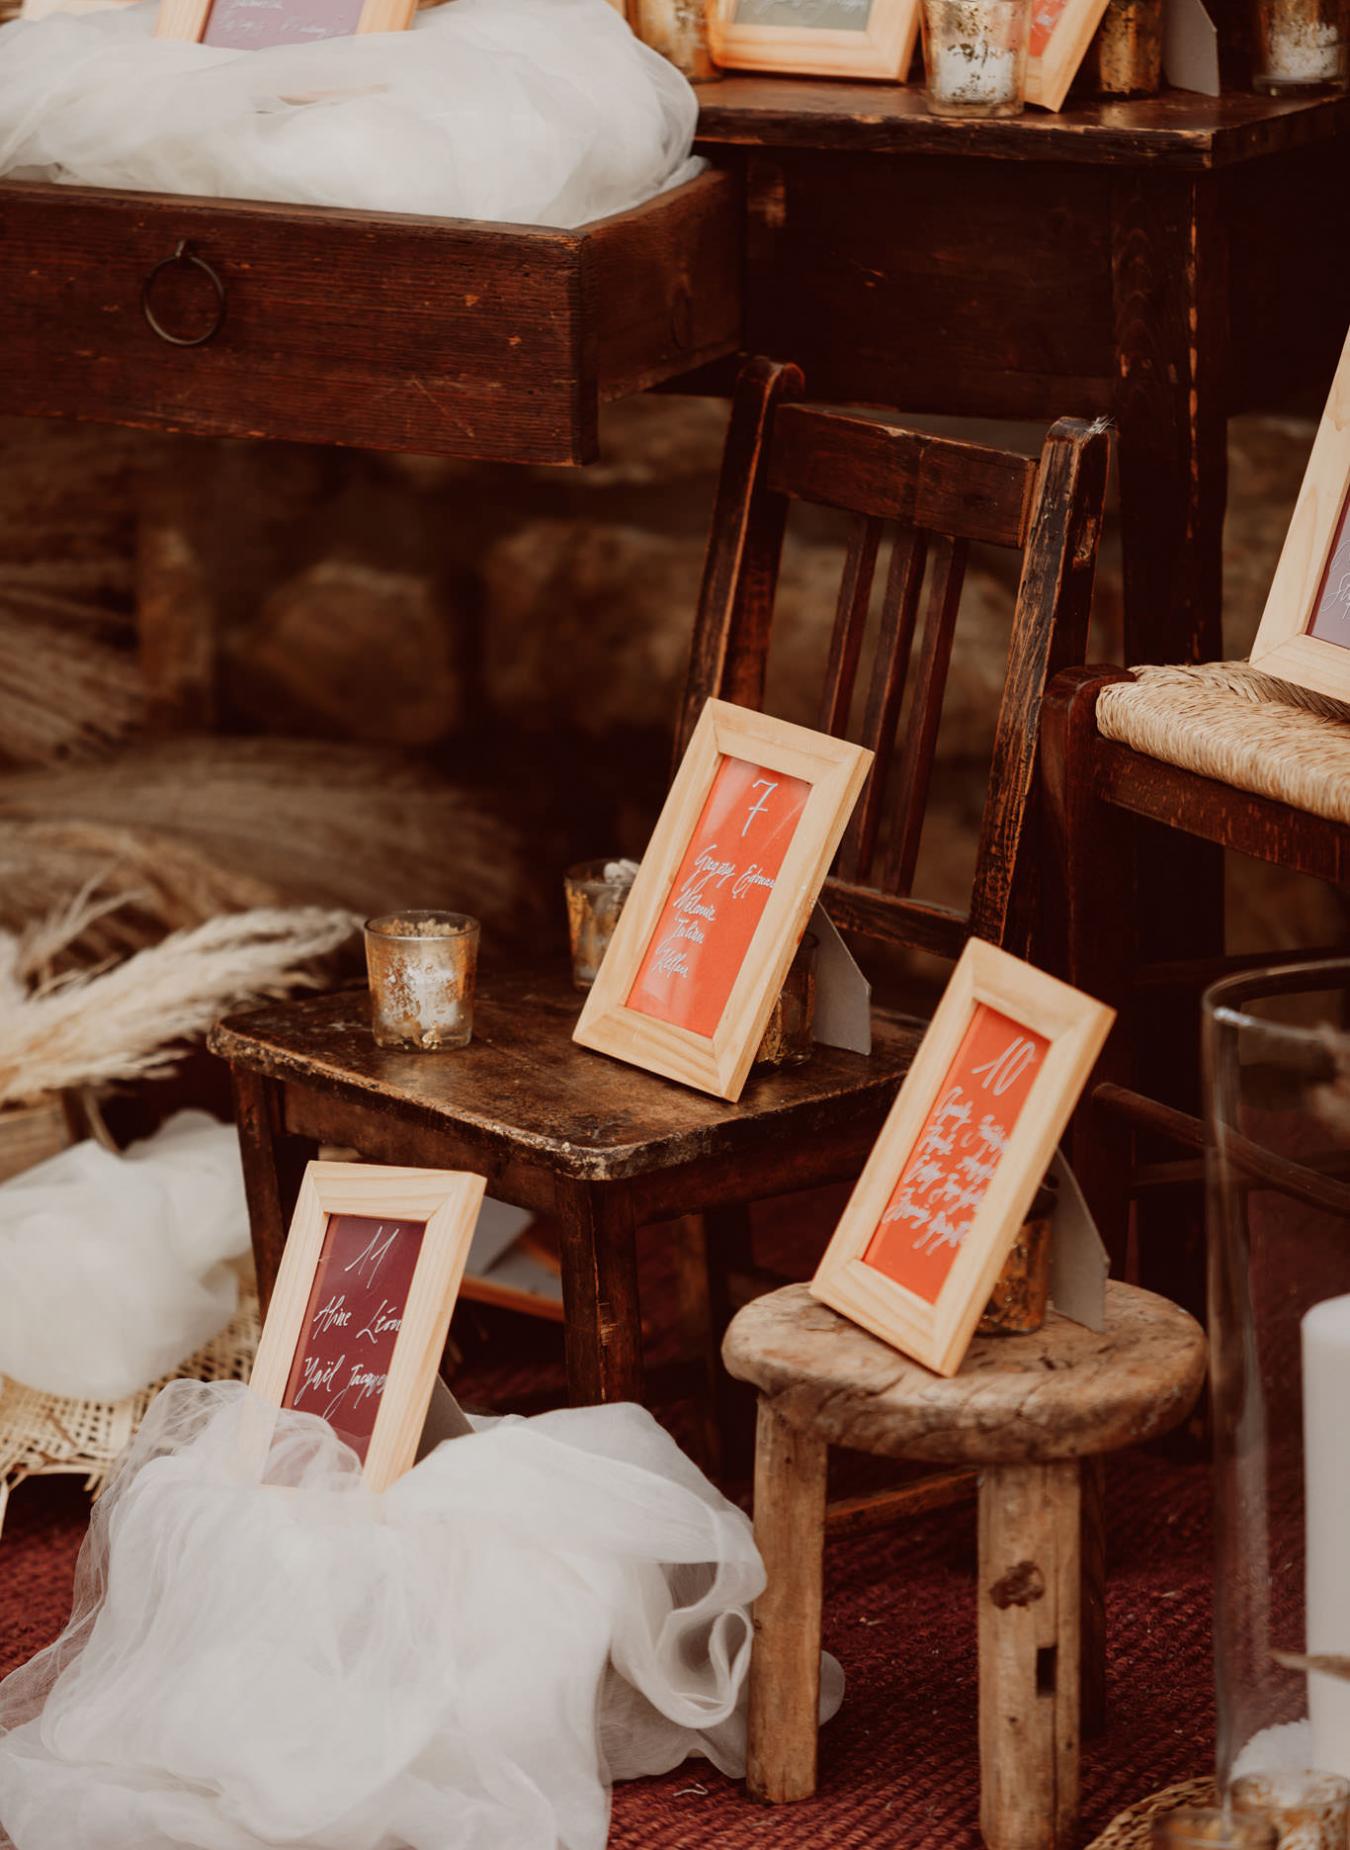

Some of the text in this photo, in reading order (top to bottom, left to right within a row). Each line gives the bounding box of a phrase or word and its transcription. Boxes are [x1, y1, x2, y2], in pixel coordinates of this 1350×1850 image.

[741, 779, 778, 837] 7
[971, 1036, 1036, 1096] 10
[344, 1225, 400, 1289] 11
[312, 1294, 352, 1340] Aline
[293, 1354, 346, 1406] Yaël
